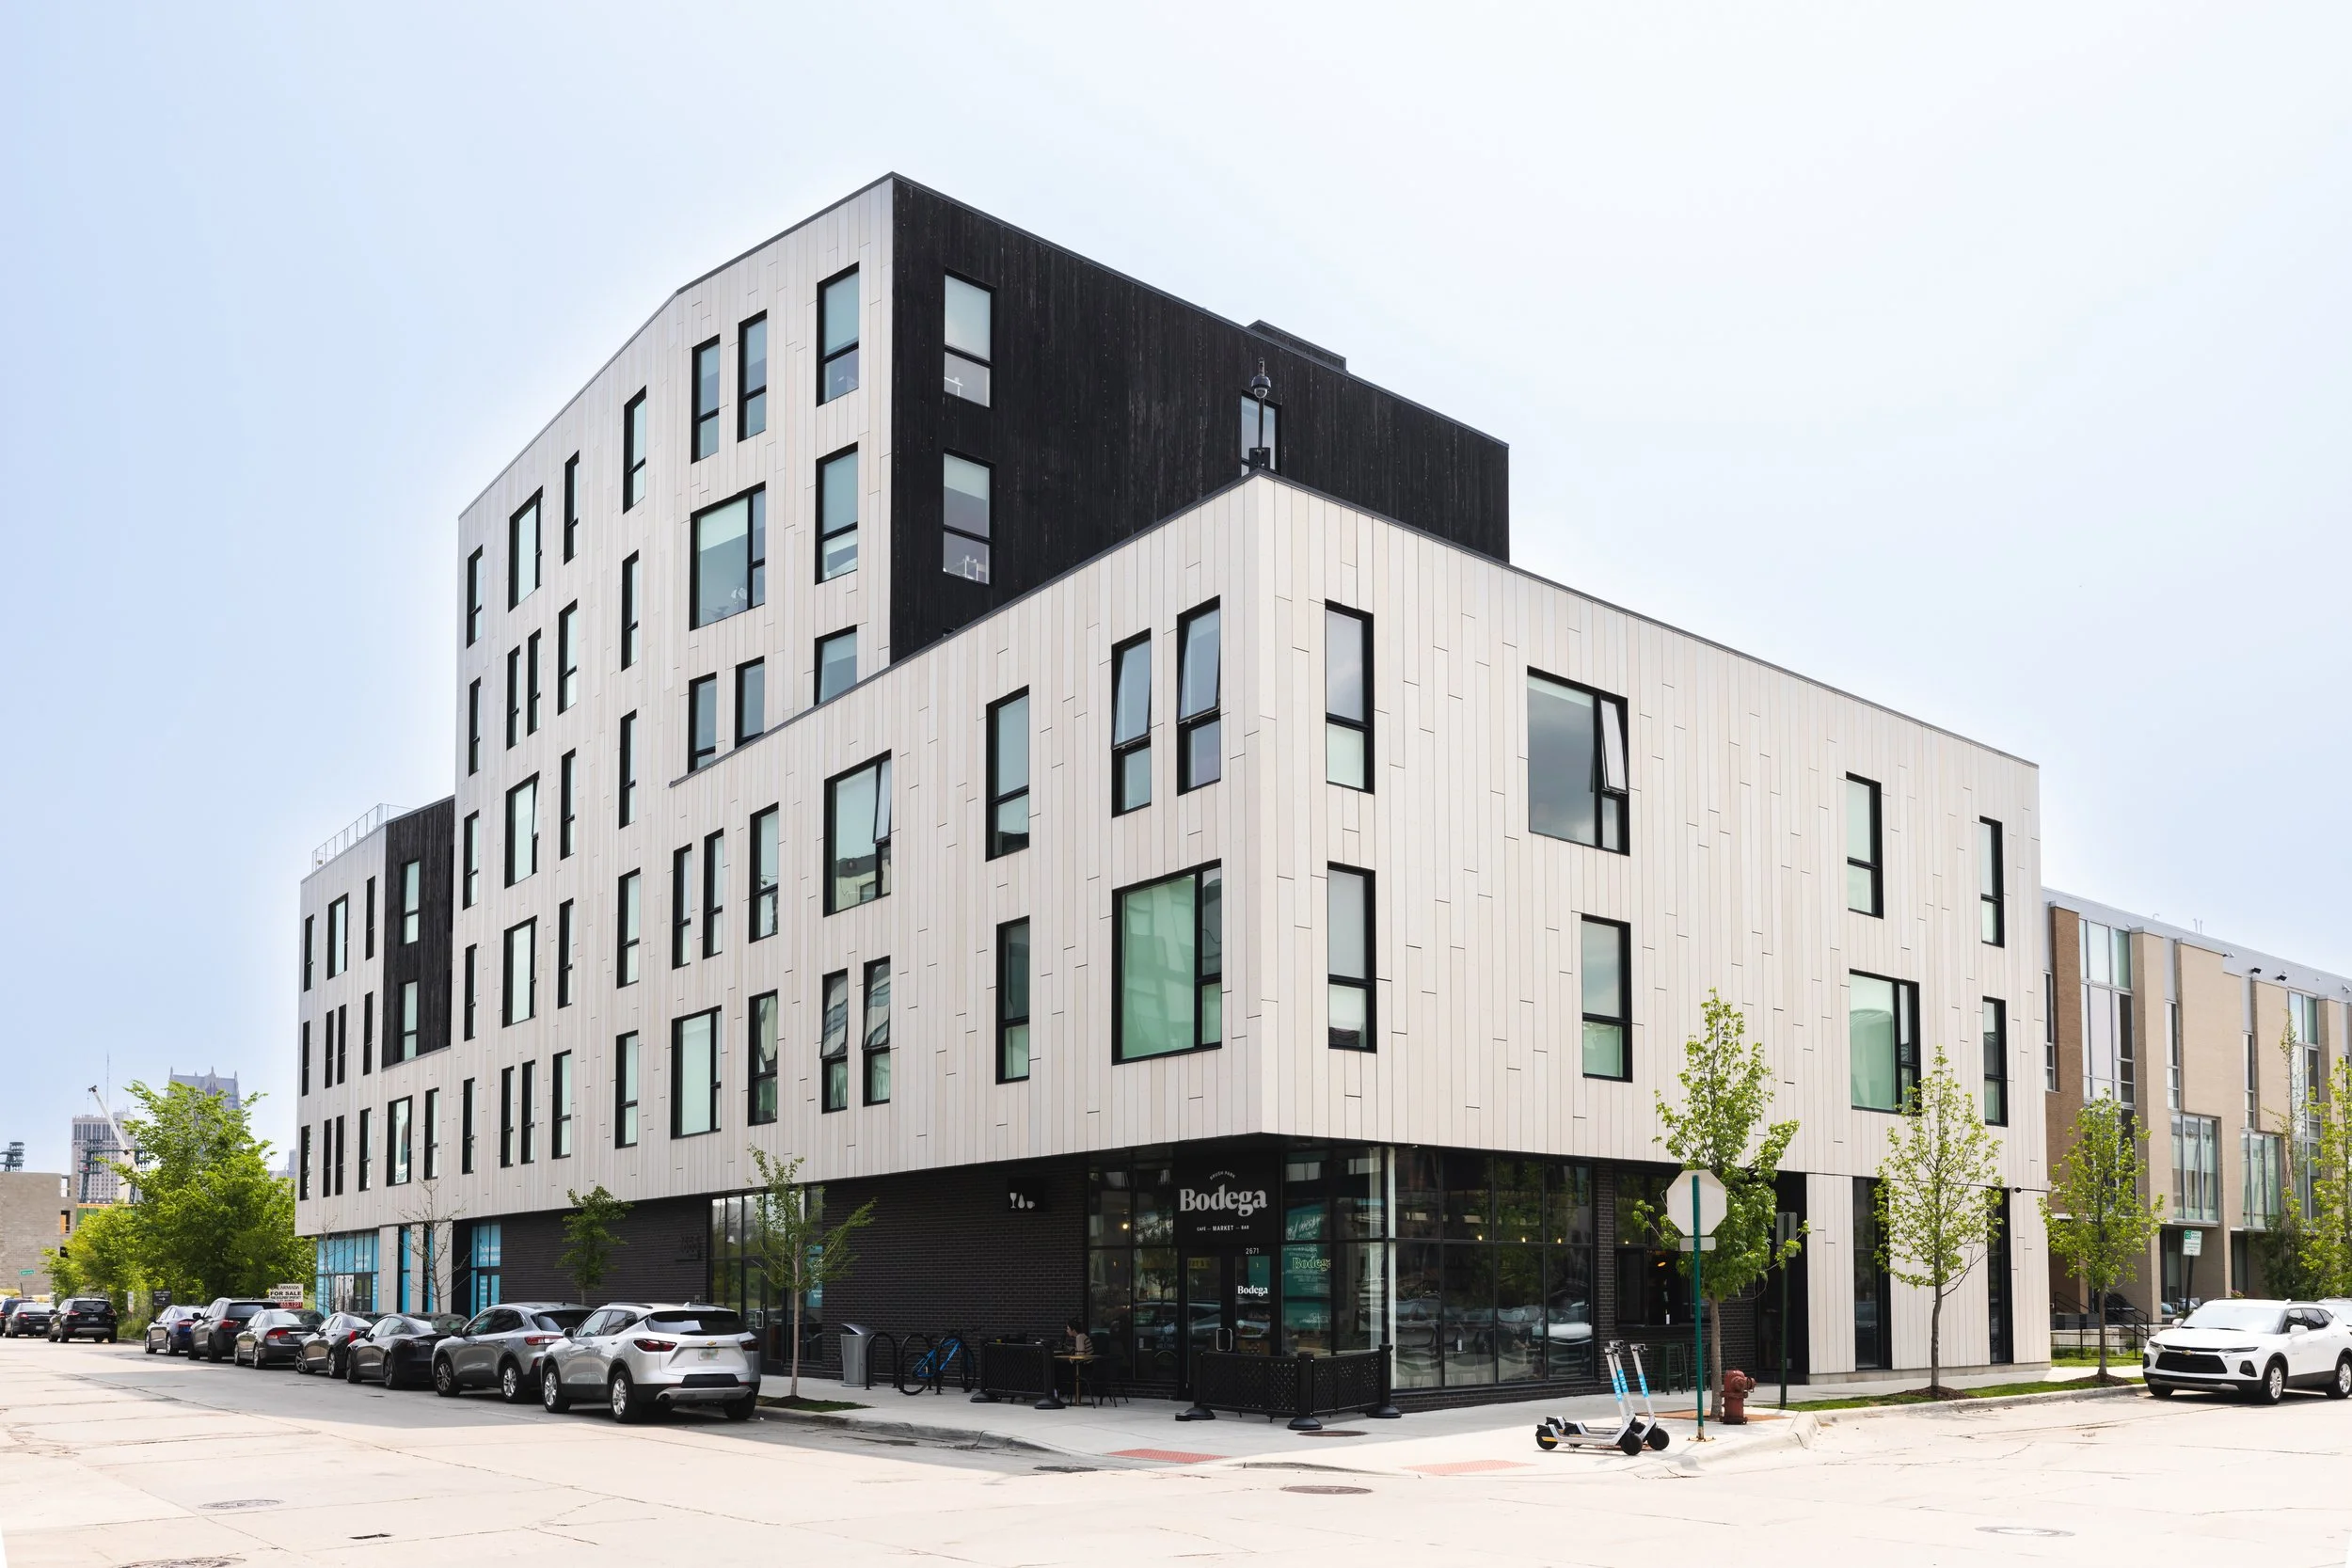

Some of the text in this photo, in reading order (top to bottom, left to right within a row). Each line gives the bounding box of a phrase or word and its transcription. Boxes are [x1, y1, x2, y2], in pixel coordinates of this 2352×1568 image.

[1224, 1170, 1235, 1179] PARK
[1179, 1183, 1267, 1217] Bodega
[1237, 1284, 1268, 1297] Bodega
